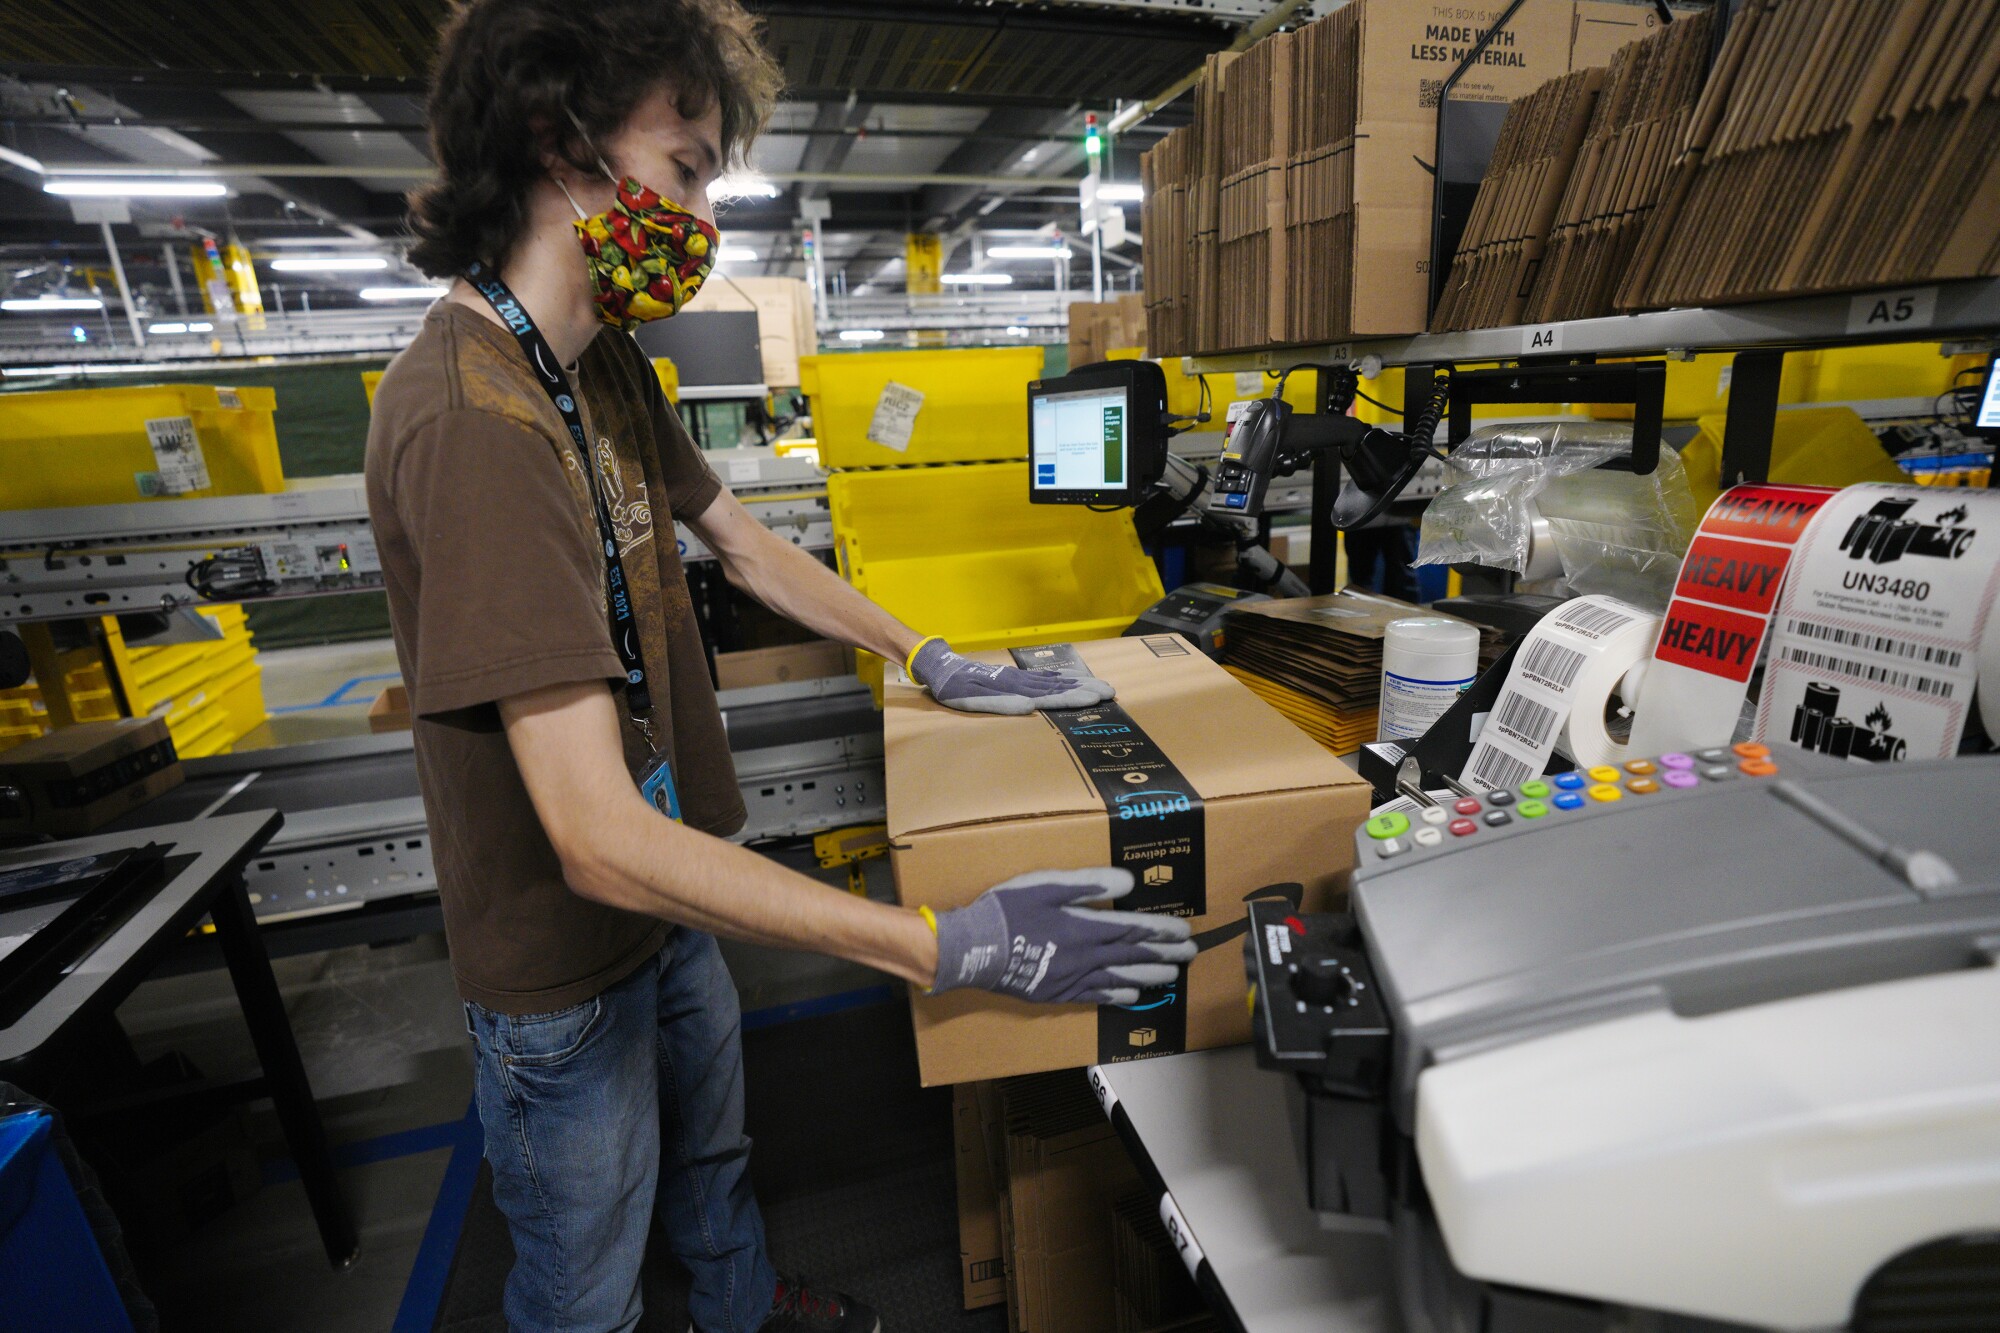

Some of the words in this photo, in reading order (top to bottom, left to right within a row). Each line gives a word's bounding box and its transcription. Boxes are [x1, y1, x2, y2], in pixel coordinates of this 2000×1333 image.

[1433, 7, 1453, 18] THIS
[1456, 9, 1475, 20] BOX
[1478, 11, 1486, 21] IS
[1426, 25, 1470, 42] MADE
[1412, 44, 1447, 62] LESS
[496, 299, 532, 335] 2021
[1867, 296, 1915, 323] A5
[1531, 330, 1554, 348] A4
[1258, 355, 1269, 366] A2
[1334, 347, 1347, 360] A3
[1709, 496, 1817, 528] HEAVY
[1682, 554, 1779, 597] HEAVY
[1842, 571, 1931, 601] UN3480
[614, 590, 630, 620] 2021
[1661, 618, 1755, 666] HEAVY
[1522, 671, 1565, 694] spPBN72R2LH
[1071, 726, 1132, 736] prime
[1498, 725, 1539, 750] spPBN72R2LJ
[1119, 795, 1191, 821] prime
[1123, 848, 1167, 861] delivery
[1169, 845, 1191, 854] free
[1112, 1055, 1131, 1063] free
[1134, 1049, 1174, 1060] delivery
